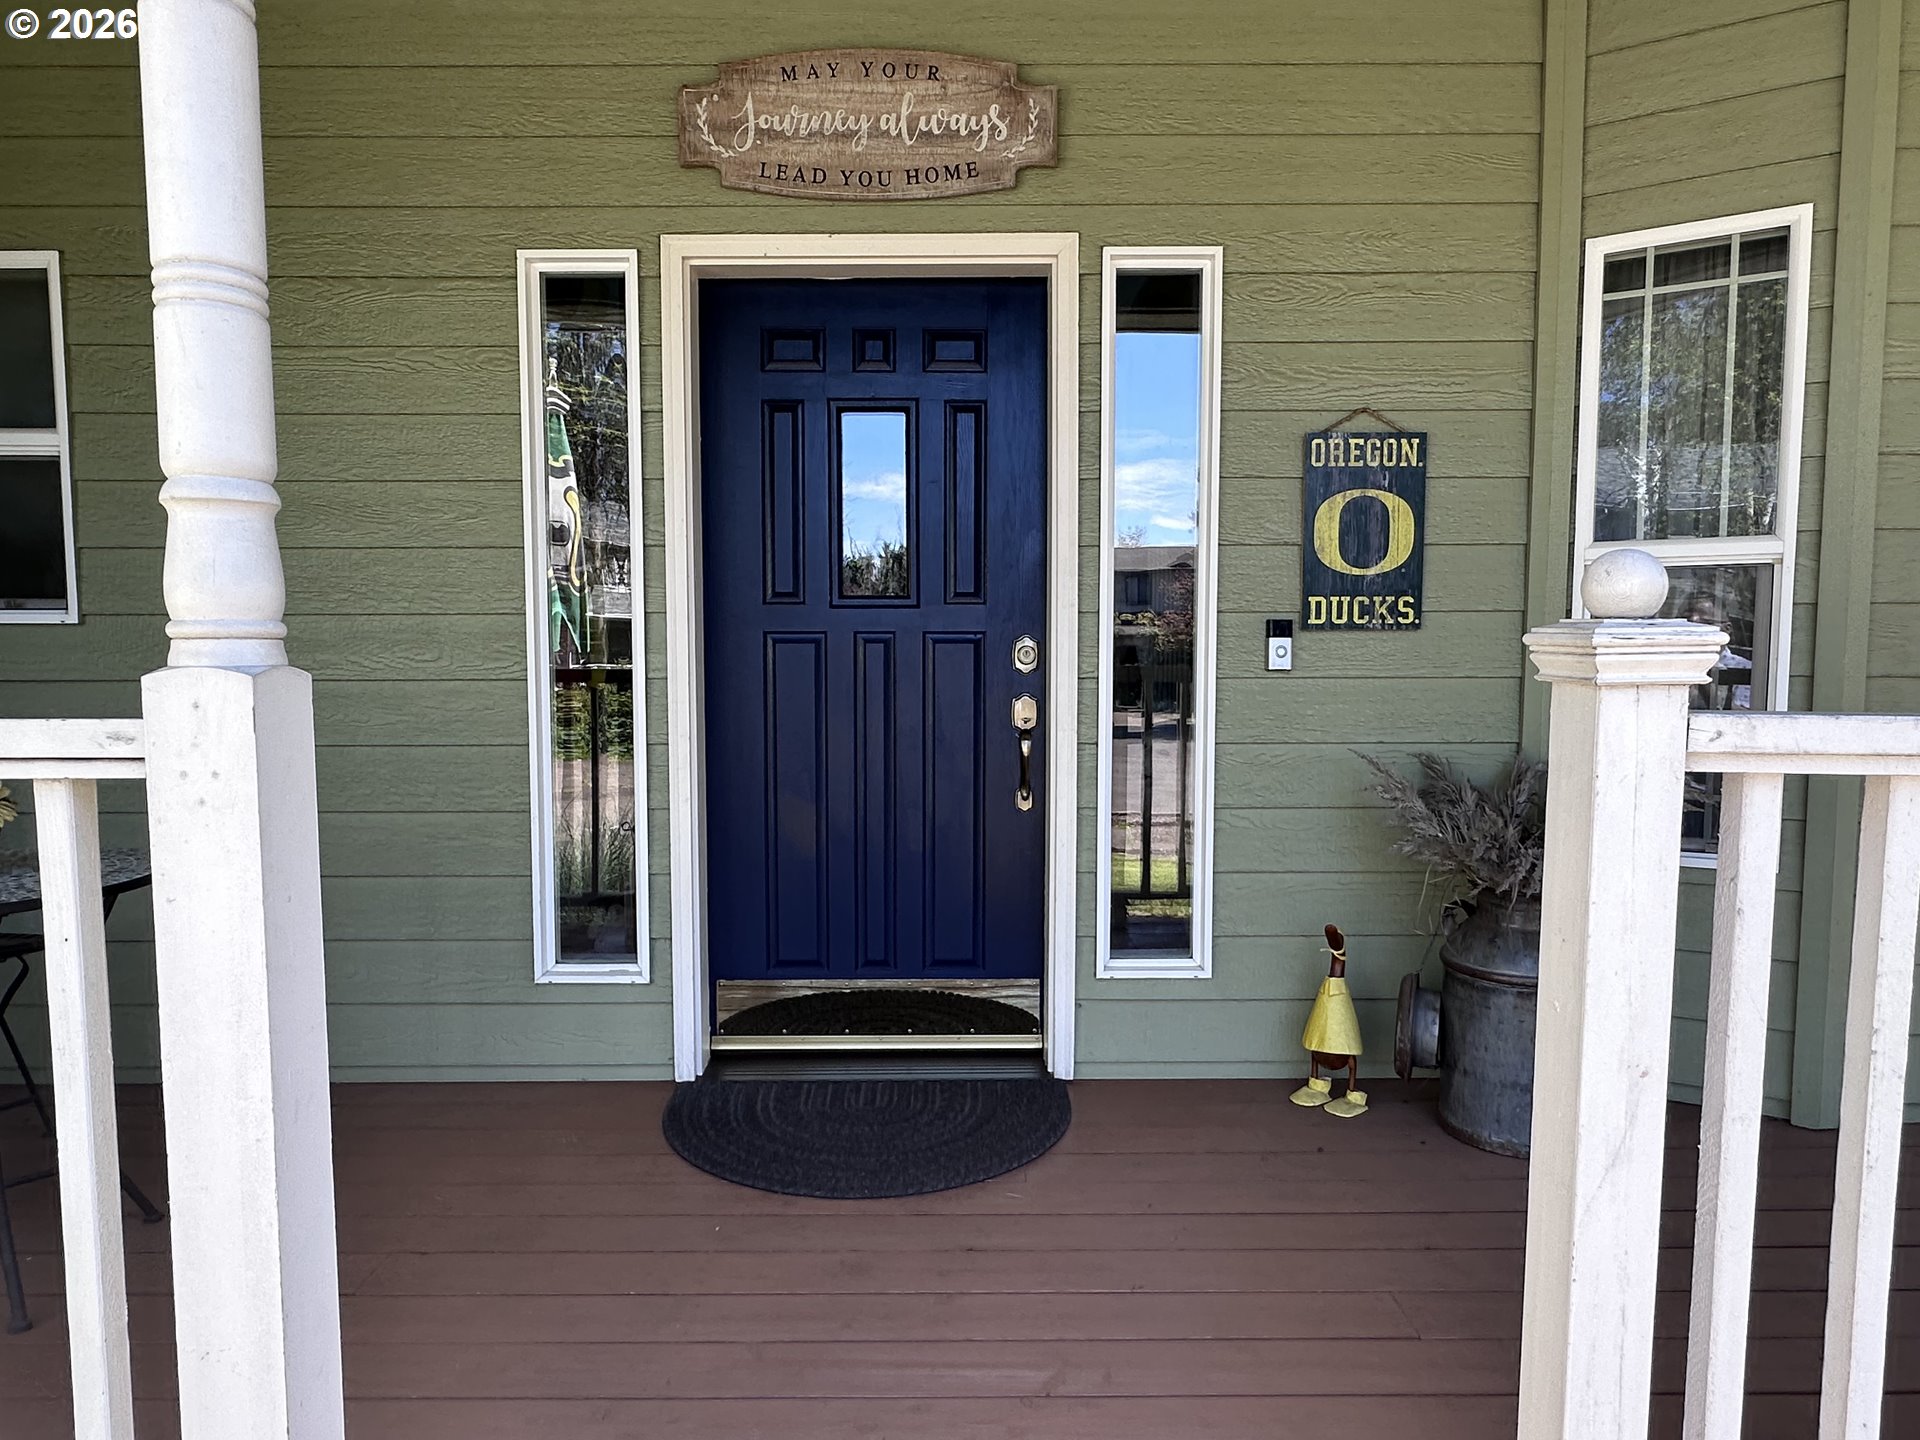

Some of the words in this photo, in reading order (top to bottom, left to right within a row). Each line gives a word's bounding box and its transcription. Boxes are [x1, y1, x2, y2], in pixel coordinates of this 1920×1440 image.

[781, 62, 840, 83] MAY
[861, 62, 942, 82] YOUR
[732, 91, 876, 152] Journey
[880, 91, 1011, 153] always
[759, 161, 828, 185] LEAD
[840, 169, 893, 187] YOU
[905, 161, 980, 186] HOME
[1313, 488, 1415, 576] O
